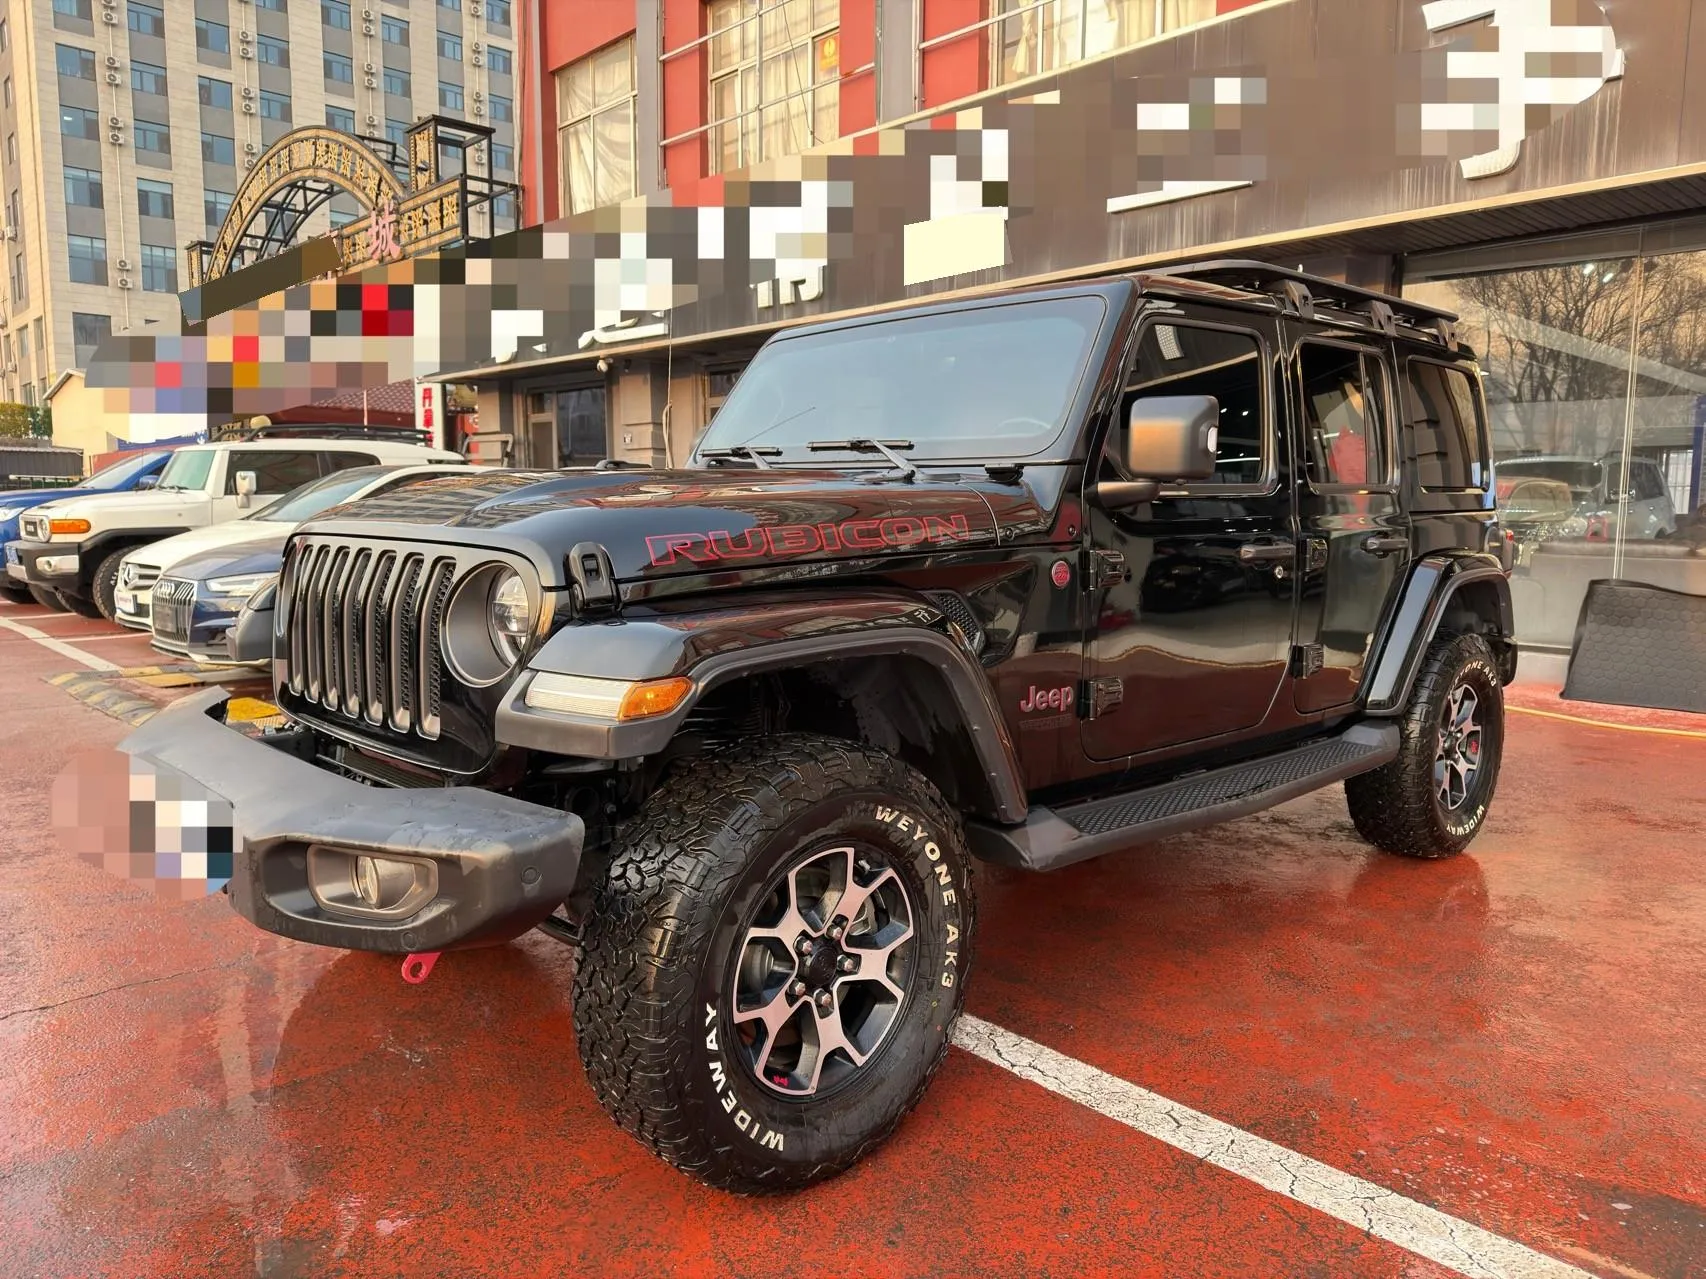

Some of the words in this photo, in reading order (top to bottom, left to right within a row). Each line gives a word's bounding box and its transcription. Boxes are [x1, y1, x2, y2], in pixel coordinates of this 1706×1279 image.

[645, 514, 969, 567] RUBICON
[1020, 685, 1074, 712] Jeep
[1446, 804, 1485, 836] WIDEWAY
[875, 805, 957, 906] WEYONE
[941, 923, 959, 988] AK3
[705, 1003, 784, 1151] WIDEWAY
